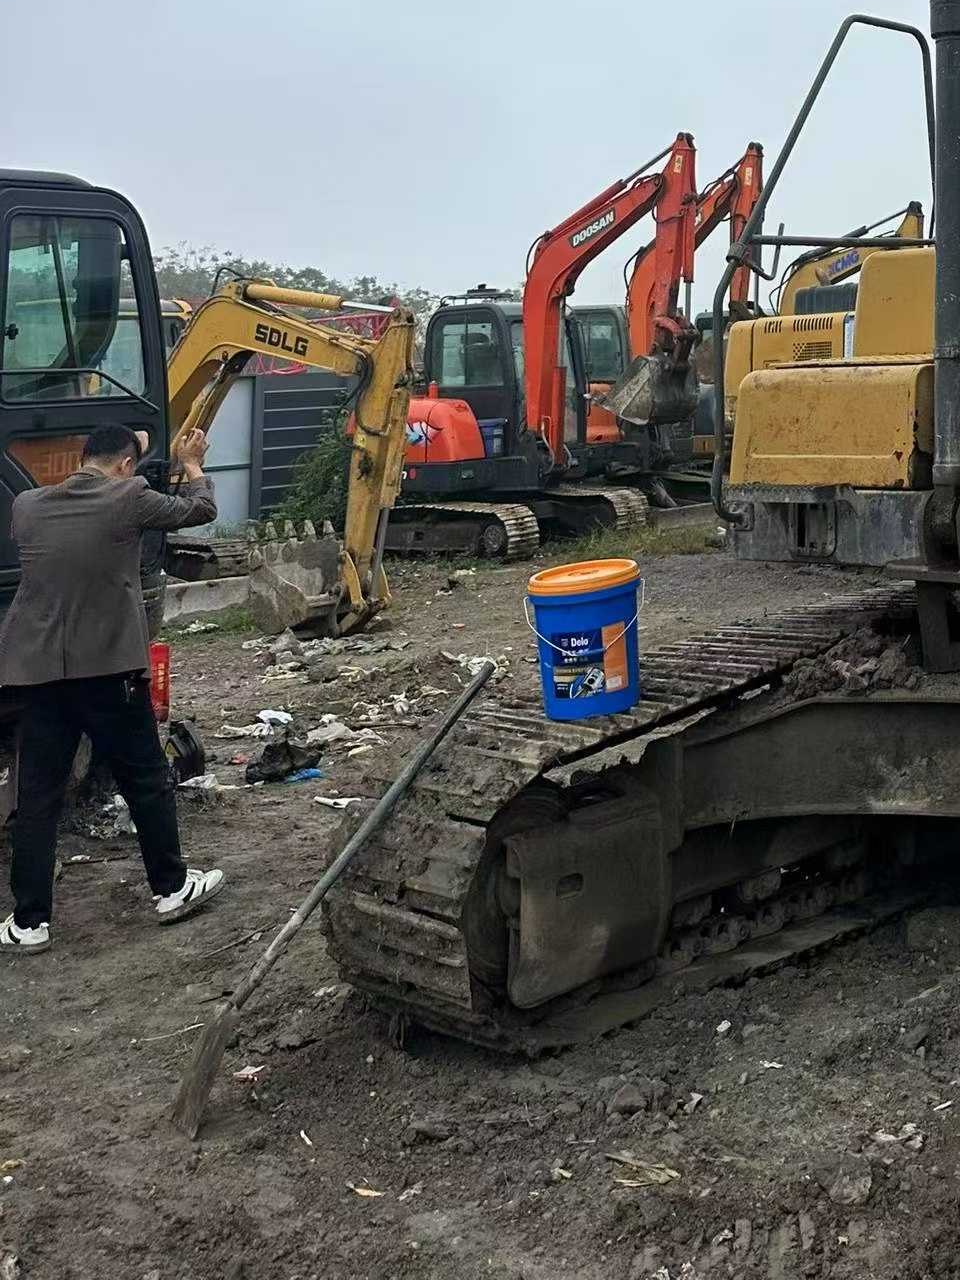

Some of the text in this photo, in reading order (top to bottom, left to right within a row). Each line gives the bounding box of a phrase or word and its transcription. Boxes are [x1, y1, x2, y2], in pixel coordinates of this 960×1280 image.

[572, 211, 614, 247] DOOSAN
[255, 323, 309, 356] SDLG
[570, 637, 589, 648] Delo
